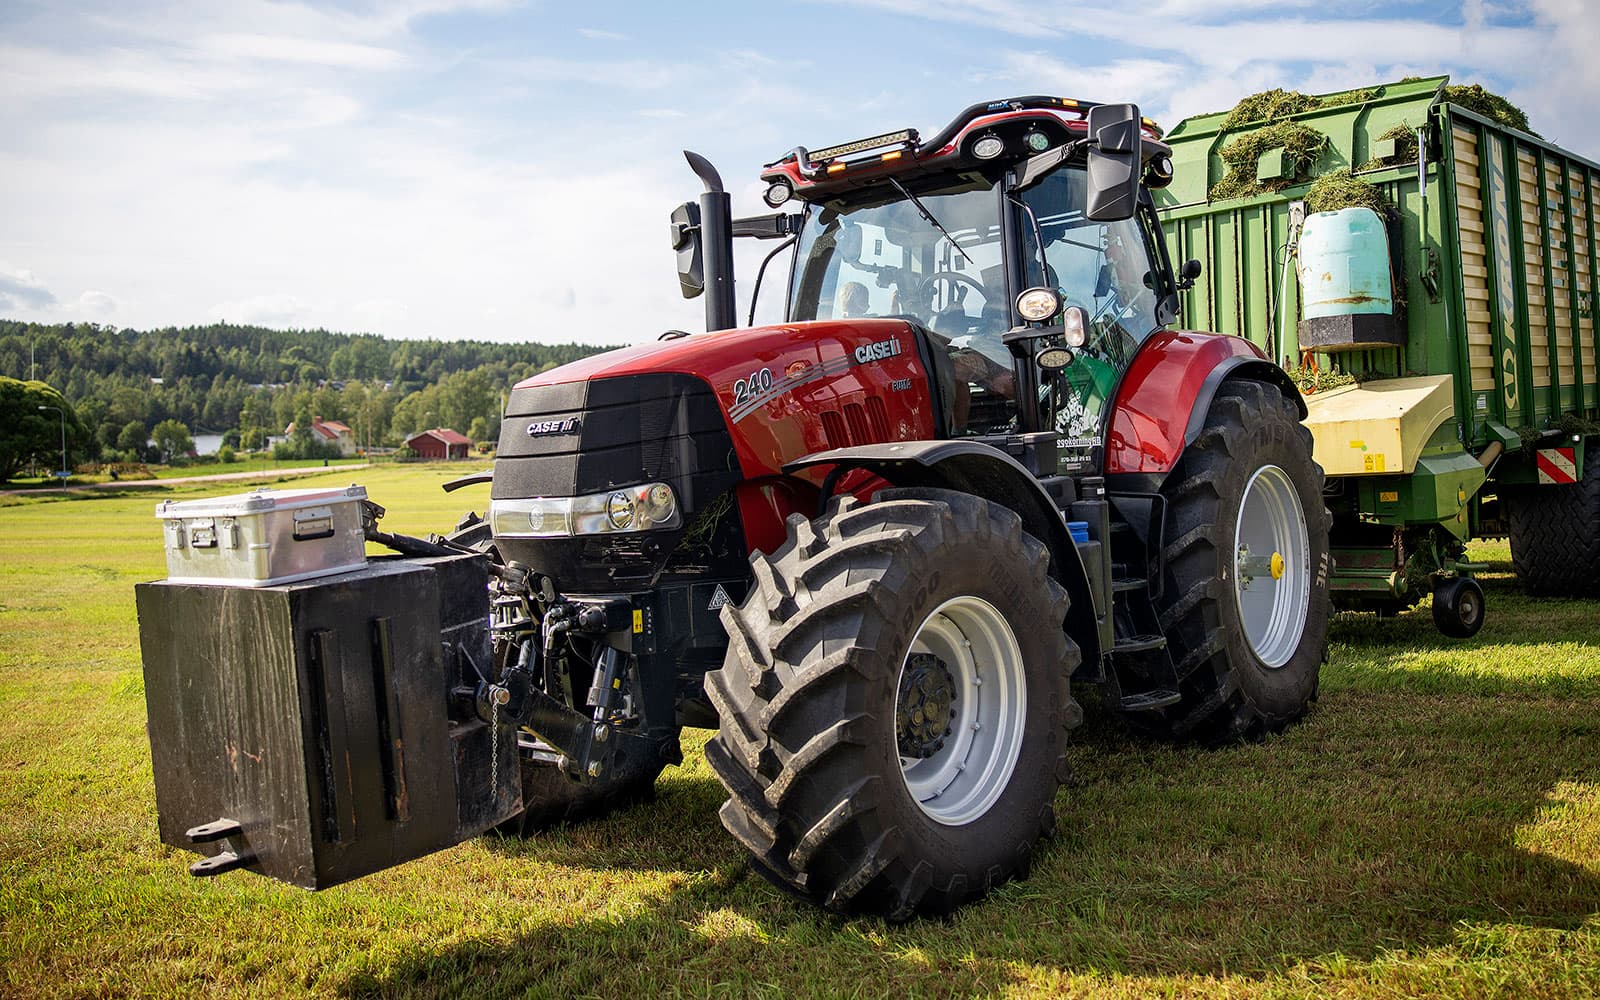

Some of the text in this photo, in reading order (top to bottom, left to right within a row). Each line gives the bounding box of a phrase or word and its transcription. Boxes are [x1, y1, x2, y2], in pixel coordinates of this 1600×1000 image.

[1491, 133, 1515, 345] KRONE
[855, 341, 890, 364] CASE
[734, 367, 772, 406] 240
[527, 420, 560, 435] CASE
